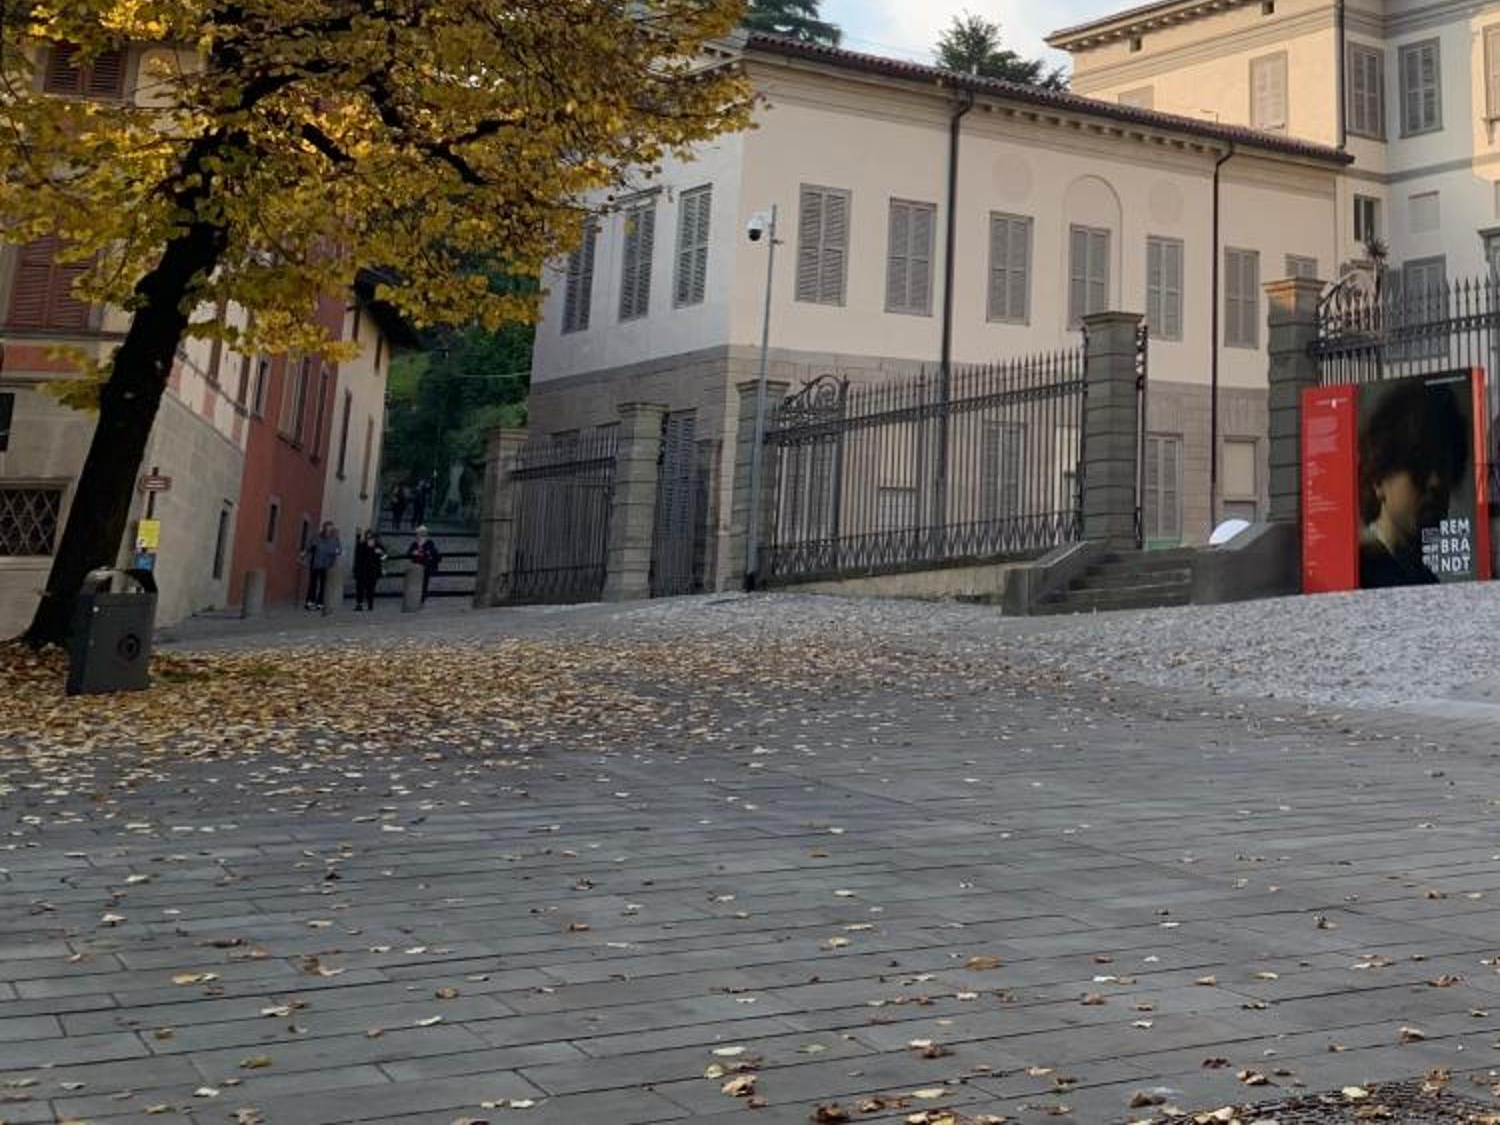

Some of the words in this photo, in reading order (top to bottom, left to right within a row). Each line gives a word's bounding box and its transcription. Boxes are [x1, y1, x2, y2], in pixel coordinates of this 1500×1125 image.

[1440, 518, 1470, 536] REM
[1440, 537, 1471, 554] BRA
[1441, 555, 1471, 572] NDT
